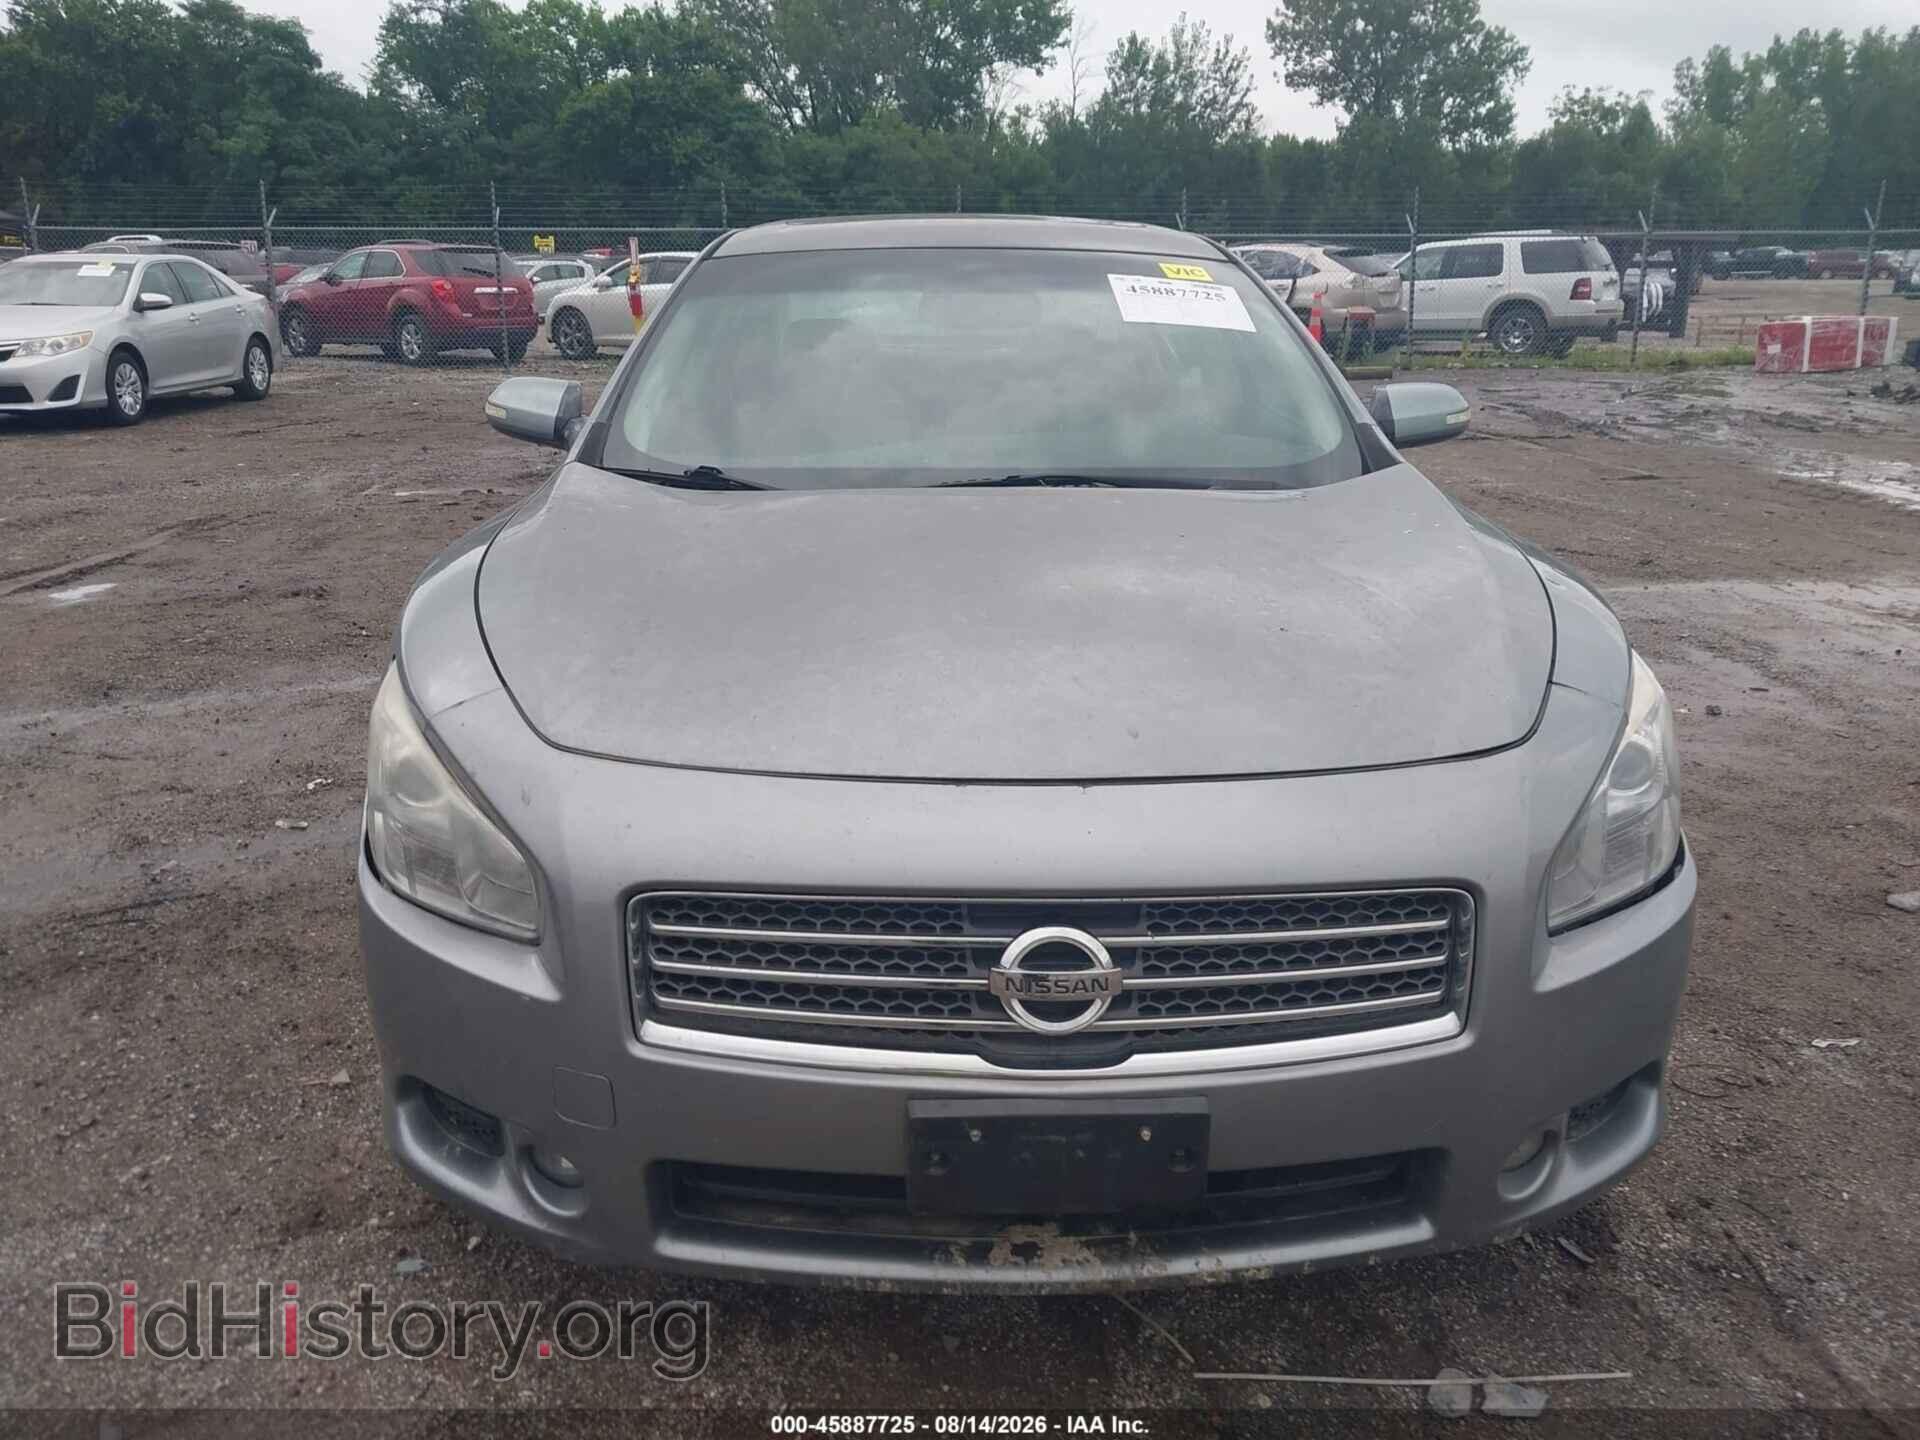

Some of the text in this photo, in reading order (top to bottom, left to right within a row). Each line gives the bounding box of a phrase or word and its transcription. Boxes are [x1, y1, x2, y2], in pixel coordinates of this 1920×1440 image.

[1165, 266, 1206, 277] VIC
[1126, 285, 1227, 302] 45887725
[1004, 977, 1109, 994] NISSAN
